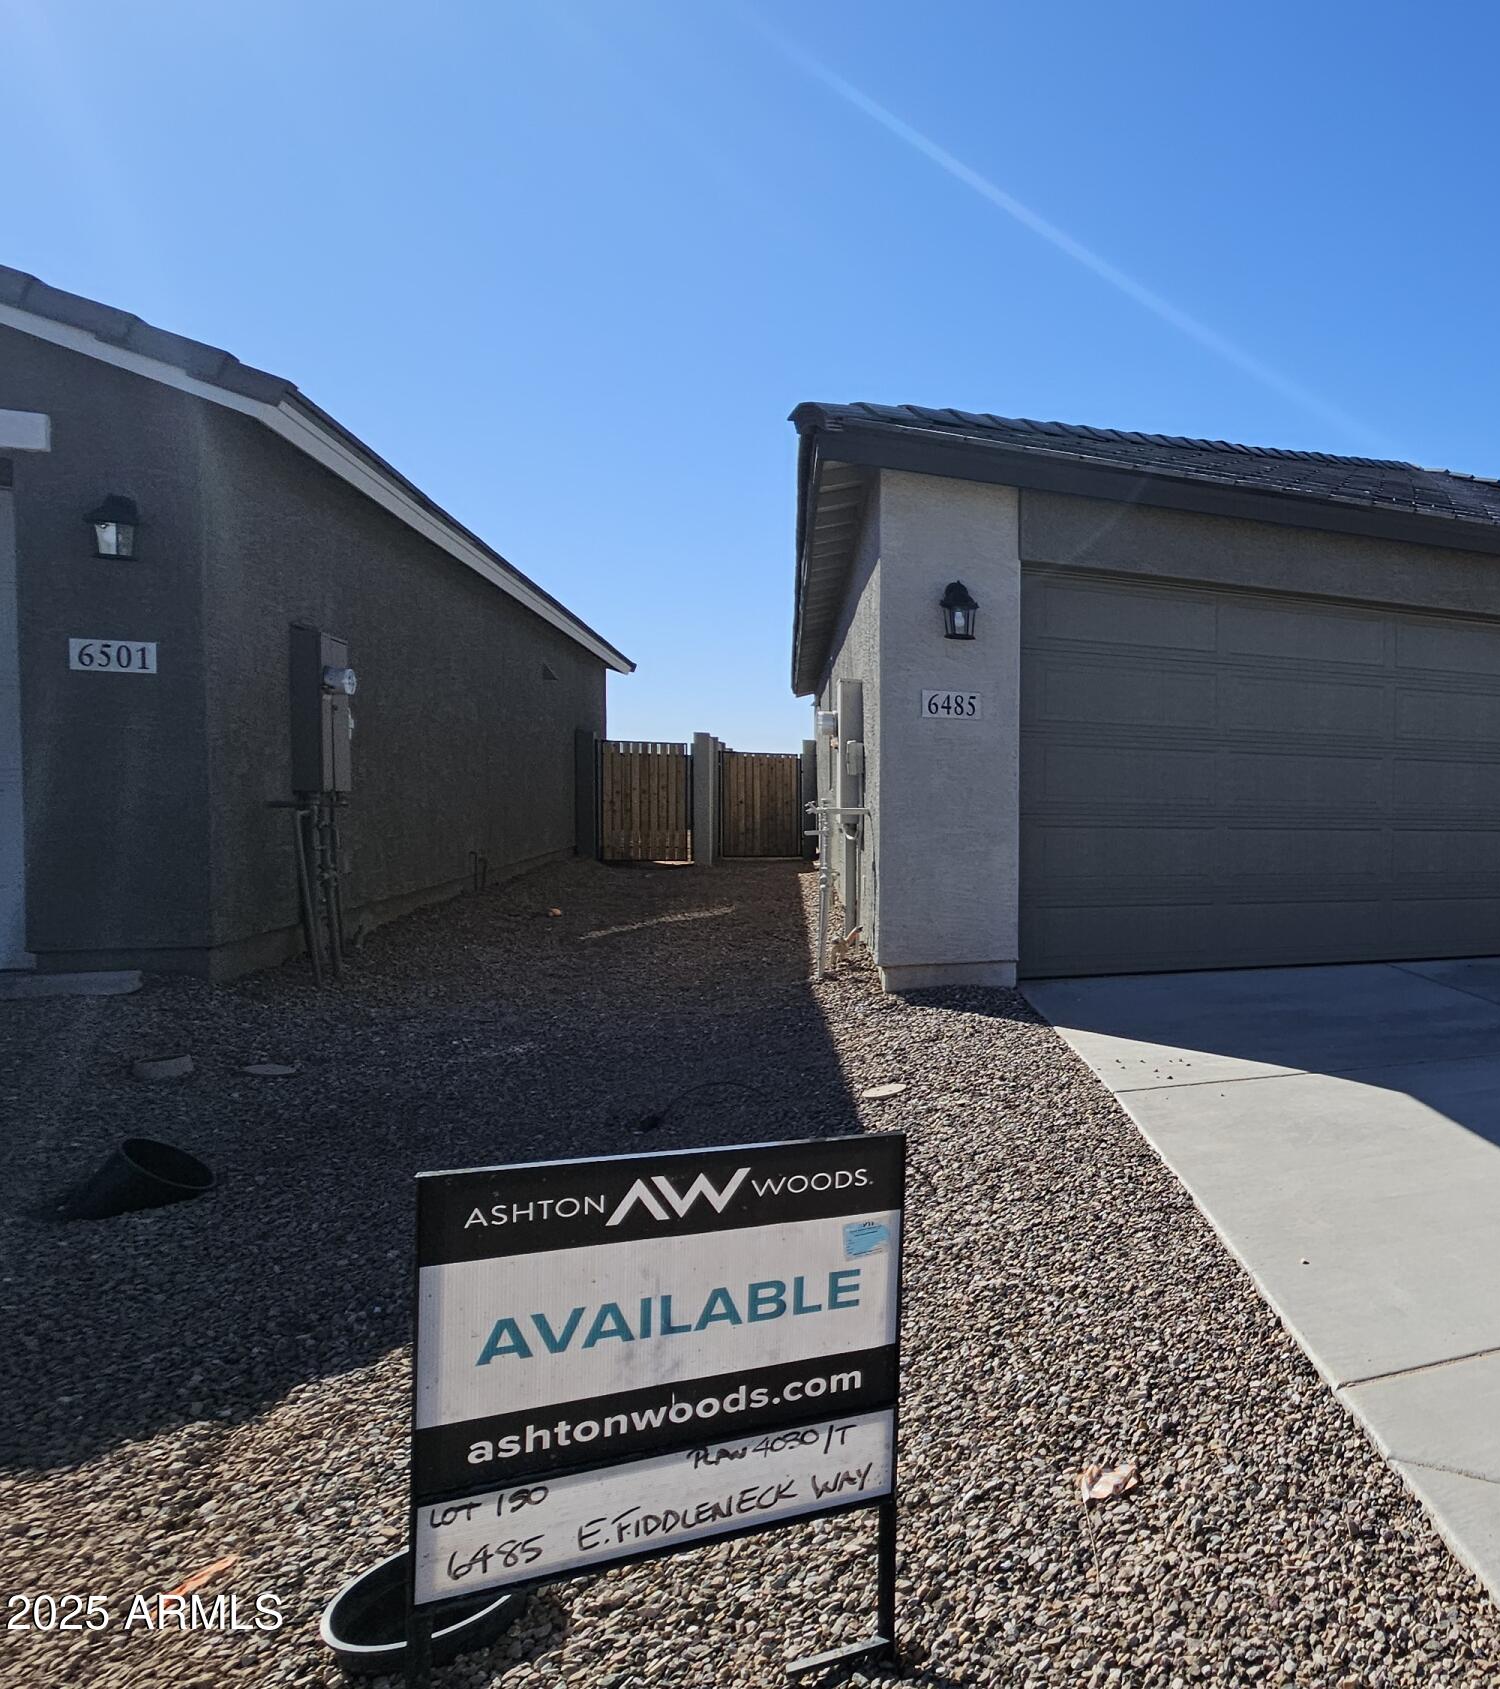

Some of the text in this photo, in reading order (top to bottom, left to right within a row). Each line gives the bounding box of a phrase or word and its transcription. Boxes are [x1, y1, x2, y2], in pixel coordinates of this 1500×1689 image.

[78, 643, 150, 670] 6501
[927, 693, 977, 717] 6485
[464, 1194, 605, 1229] ASHTON
[475, 1268, 862, 1367] AVAILABLE
[467, 1368, 863, 1465] ashtonwoods.com
[430, 1501, 482, 1528] LOT
[447, 1534, 545, 1580] 6485
[811, 1462, 873, 1499] WAY
